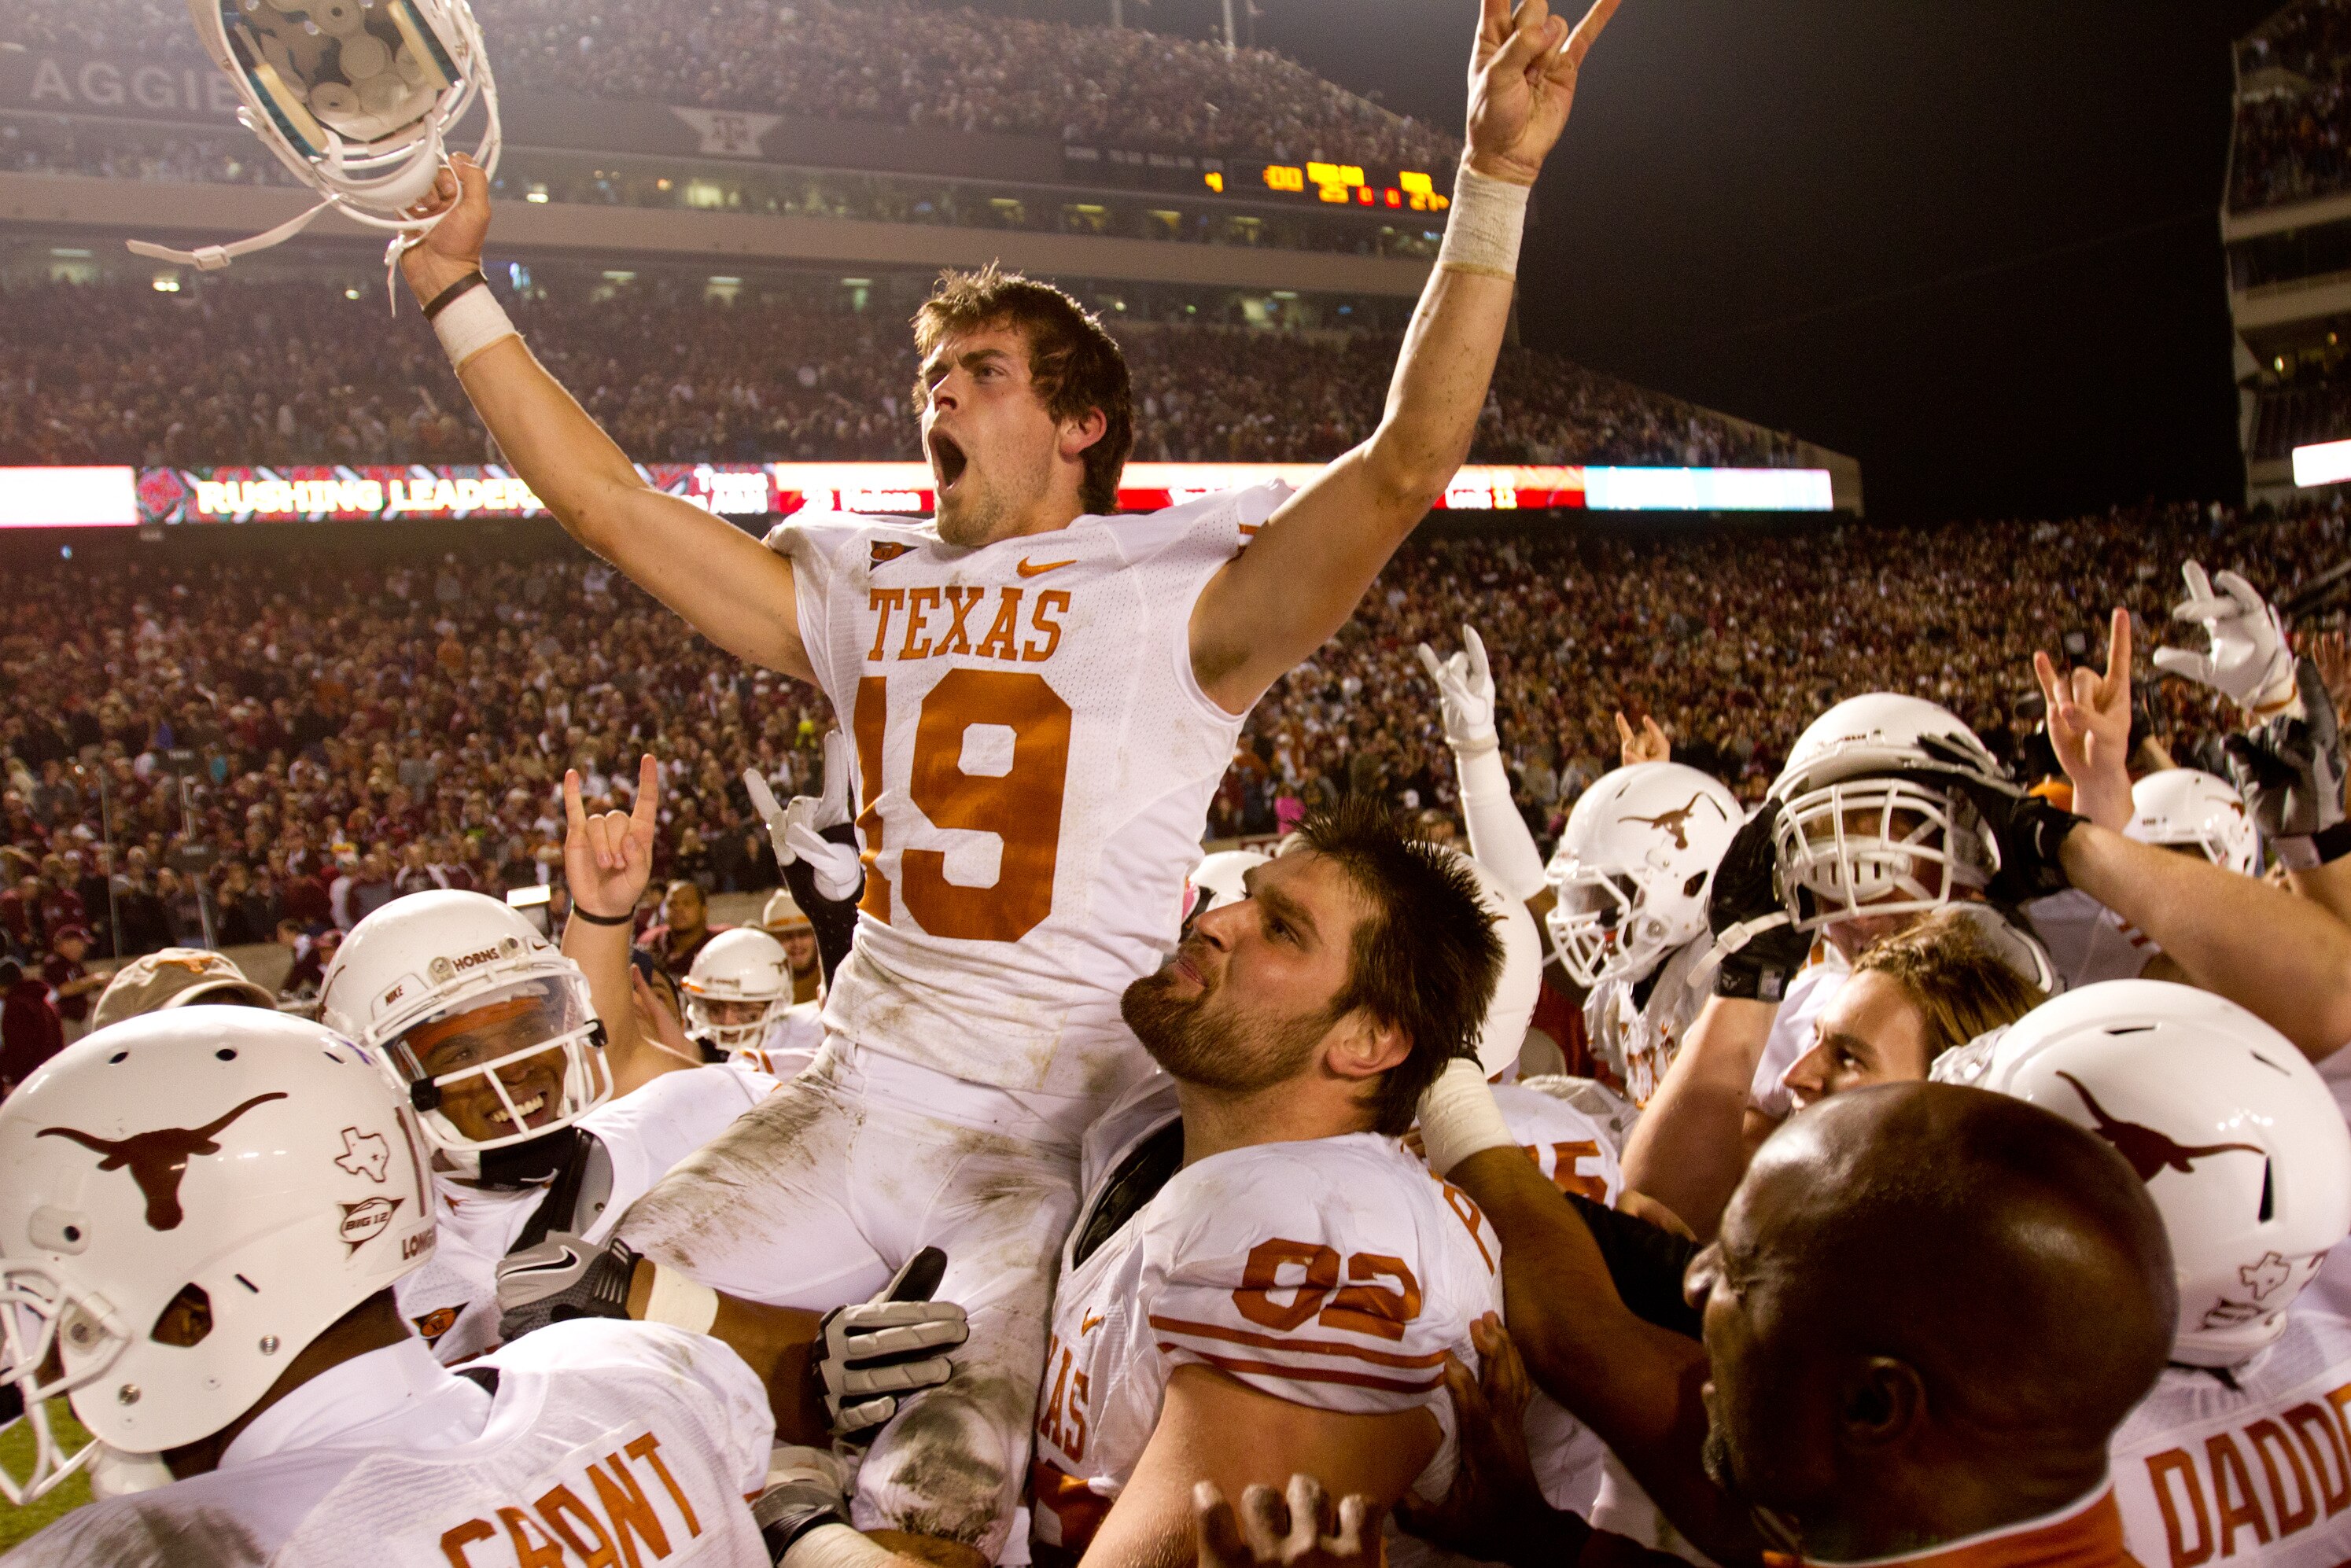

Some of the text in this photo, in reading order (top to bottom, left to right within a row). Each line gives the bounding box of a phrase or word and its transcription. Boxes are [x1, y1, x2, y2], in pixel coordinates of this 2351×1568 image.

[197, 480, 384, 513] RUSHING
[868, 586, 1071, 661] TEXAS
[853, 668, 1072, 942] 19
[452, 948, 500, 972] HORNS
[345, 1212, 389, 1231] BIG 12
